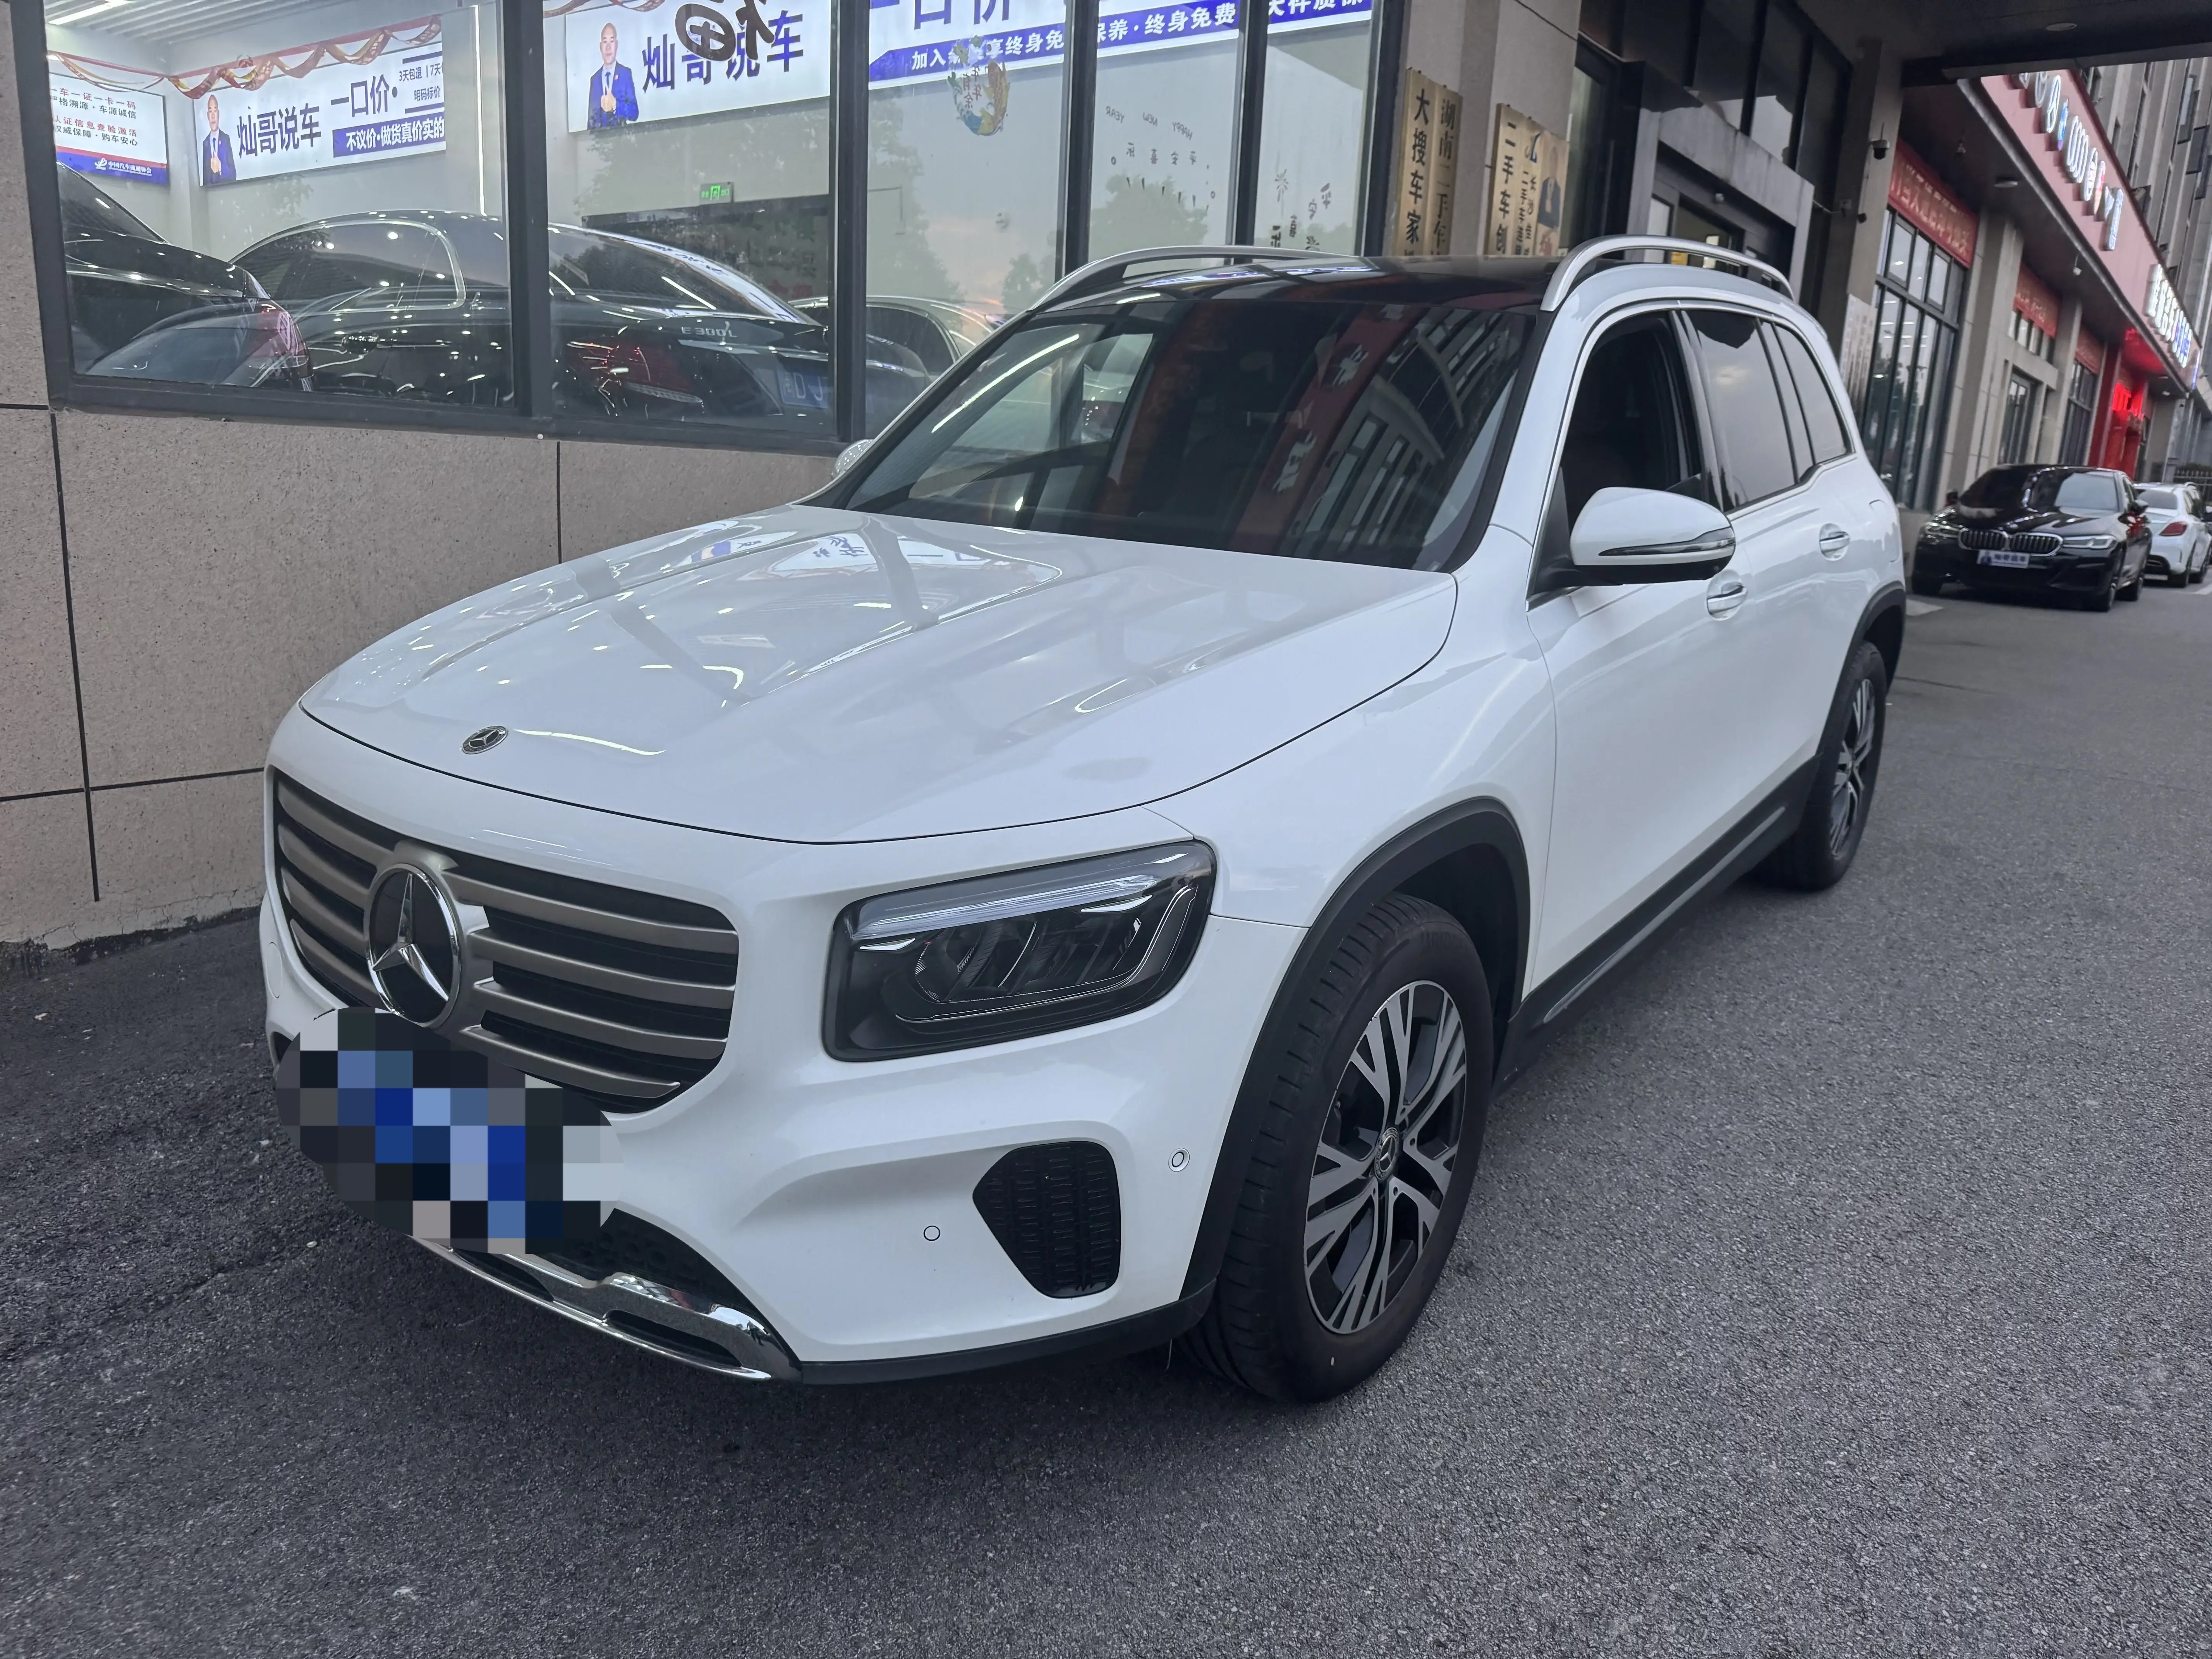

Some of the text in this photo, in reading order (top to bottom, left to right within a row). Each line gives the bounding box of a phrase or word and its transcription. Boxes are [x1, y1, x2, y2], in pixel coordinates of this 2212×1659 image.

[399, 67, 422, 82] 3天包退
[237, 103, 322, 159] 灿哥说车
[1404, 88, 1430, 256] 大搜车家
